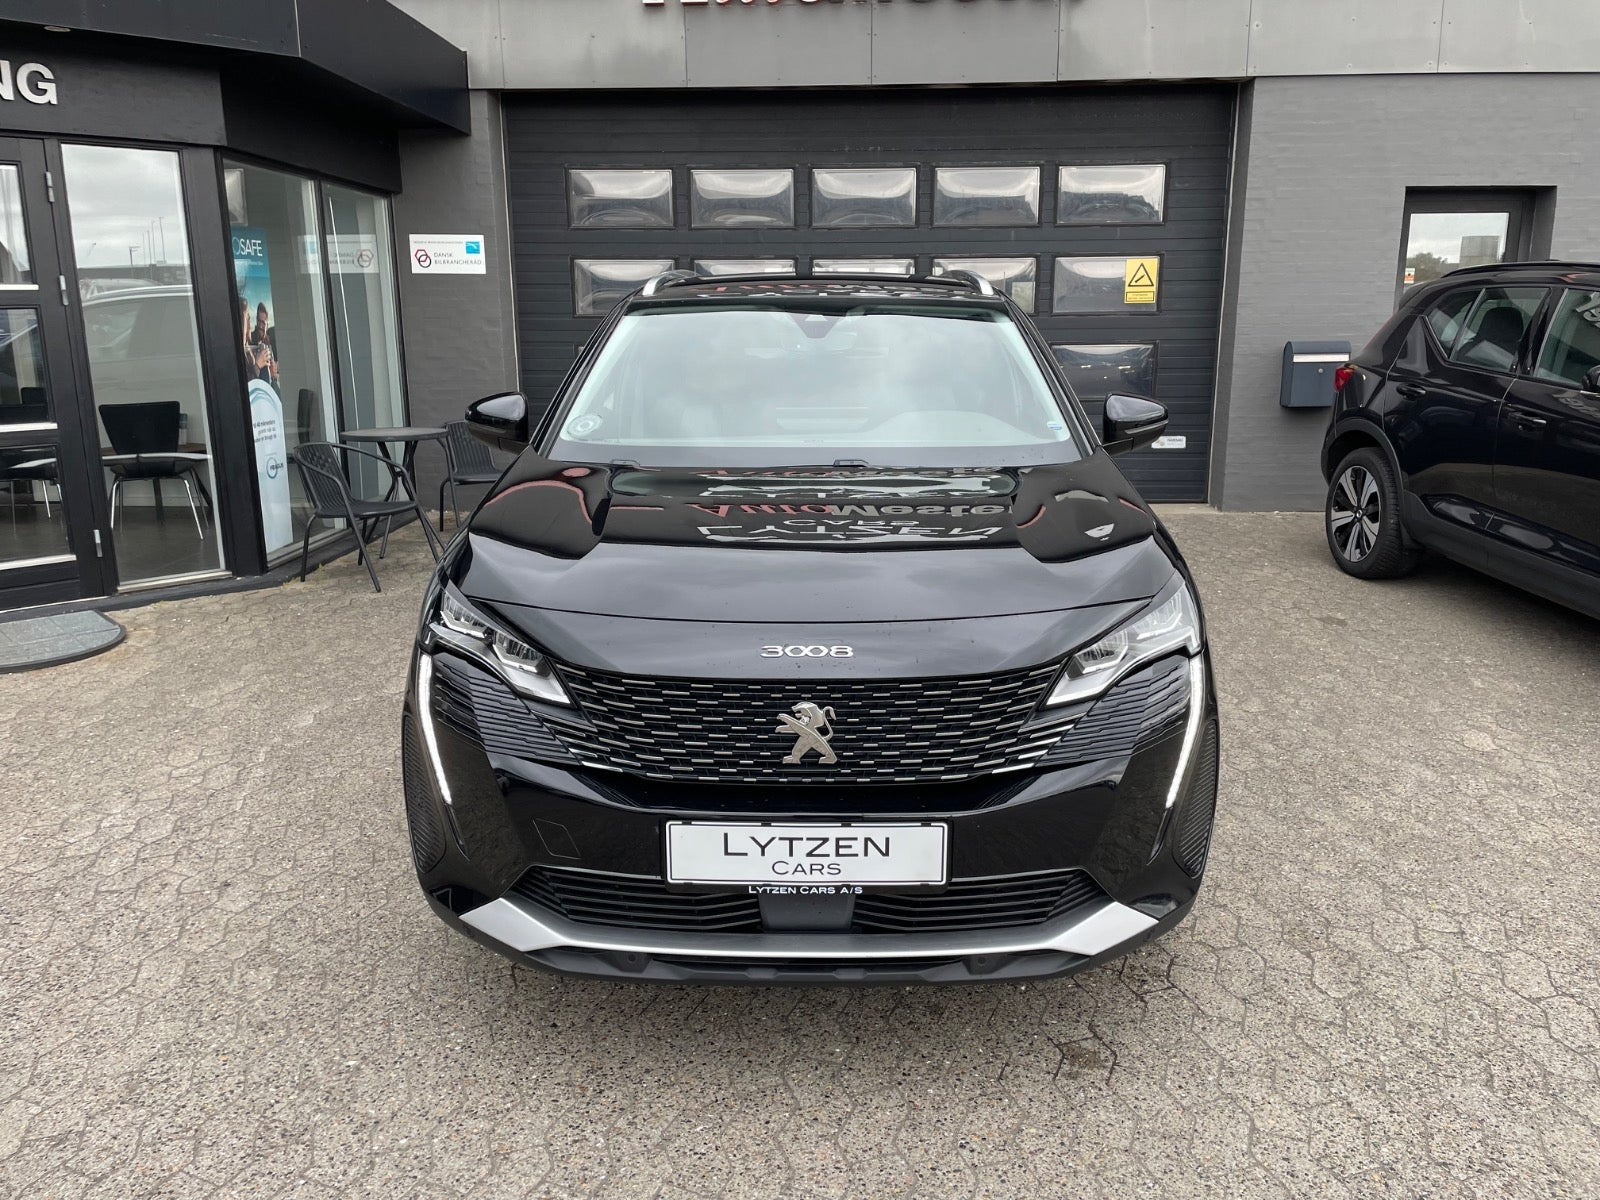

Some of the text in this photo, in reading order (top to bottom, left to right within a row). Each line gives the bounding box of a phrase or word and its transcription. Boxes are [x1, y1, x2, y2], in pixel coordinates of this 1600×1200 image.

[760, 645, 854, 658] 3008
[723, 832, 890, 858] LYTZEN
[771, 860, 842, 876] CARS
[748, 885, 863, 895] LYTZEN CARS A/S
